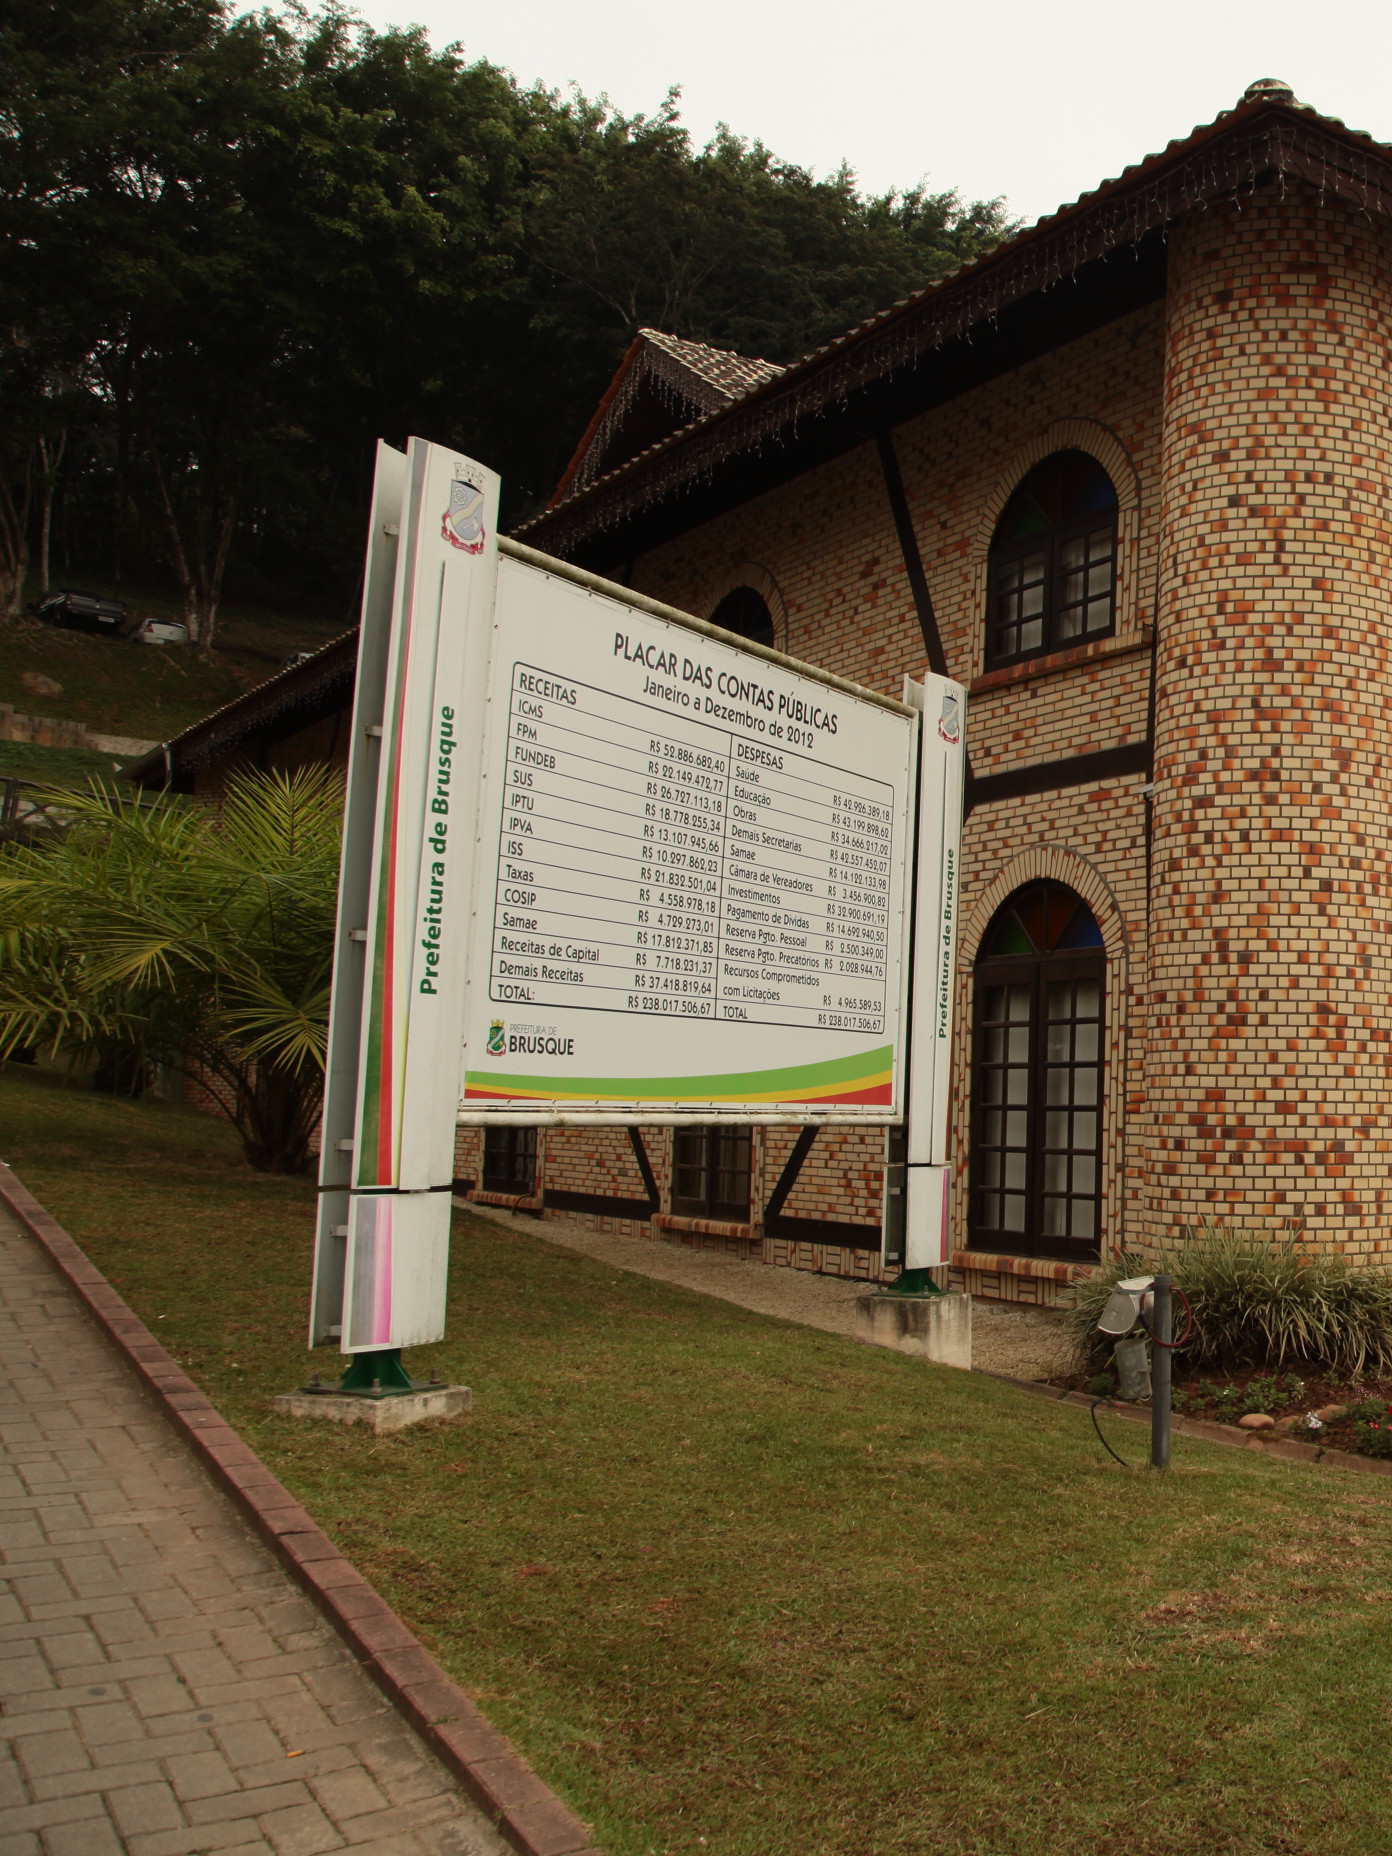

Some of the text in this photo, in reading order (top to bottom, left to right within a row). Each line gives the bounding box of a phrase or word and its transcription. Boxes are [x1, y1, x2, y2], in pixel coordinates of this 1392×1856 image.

[520, 673, 576, 705] RECEITAS
[614, 632, 838, 734] PLACAR DAS CONTAS PÚBLICAS
[643, 675, 813, 749] Janeiro a Dezembro de 2012
[517, 723, 723, 793] FPM R$ 22.149.472,77
[519, 699, 724, 773] ICMS R$ 52.886.682,40
[738, 743, 784, 769] DESPESAS
[513, 770, 720, 832] SUS R$ 18.778.255,34
[515, 746, 722, 812] FUNDEB R$ 26.727.113,18
[736, 766, 889, 821] Saúde R$ 42.926.389,18
[512, 793, 719, 853] IPTU R$ 13.107.945,66
[733, 805, 888, 855] Obras R$ 34.666.217,02
[735, 785, 889, 838] Educação R$ 43.199.898,62
[420, 706, 457, 995] Prefeitura de Brusque
[508, 840, 716, 892] ISS R$ 21.832.501,04
[510, 817, 717, 872] IPVA R$ 10.297.862,23
[731, 844, 886, 889] Samae R$ 14.122.133,98
[732, 825, 887, 872] Demais Secretarias R$ 42.557.452,07
[506, 864, 715, 913] Taxas R$ 4.558.978,18
[728, 884, 885, 924] Investimentos R$ 32.900.691,19
[729, 864, 885, 908] Câmara de Vereadores R$ 3.456.900,82
[503, 912, 713, 954] Samae R$ 17.812.371,85
[504, 888, 714, 933] COSIP R$ 4.729.273,01
[727, 904, 769, 922] Pagamento
[772, 911, 782, 923] de
[827, 922, 834, 932] R$
[838, 924, 884, 942] 14.692.940,50
[501, 936, 712, 974] Receitas de Capital R$ 7.718.231,37
[725, 944, 883, 977] Reserva Pgto. Precatórios R$ 2.028.944,76
[726, 924, 883, 959] Reserva Pgto. Pessoal R$ 2.500.349,00
[939, 848, 954, 1038] Prefeitura de Brusque
[500, 960, 711, 994] Demais Receitas R$ 37.418.819,64
[724, 964, 819, 986] Recursos Comprometidos
[498, 985, 711, 1015] TOTAL: R$ 238.017.506,67
[723, 986, 881, 1012] com Licitações R$ 4.965.589,53
[723, 1006, 880, 1030] TOTAL R$ 238.017.506,67
[509, 1036, 574, 1056] BRUSQUE
[510, 1024, 557, 1035] PREFEITURA DE
